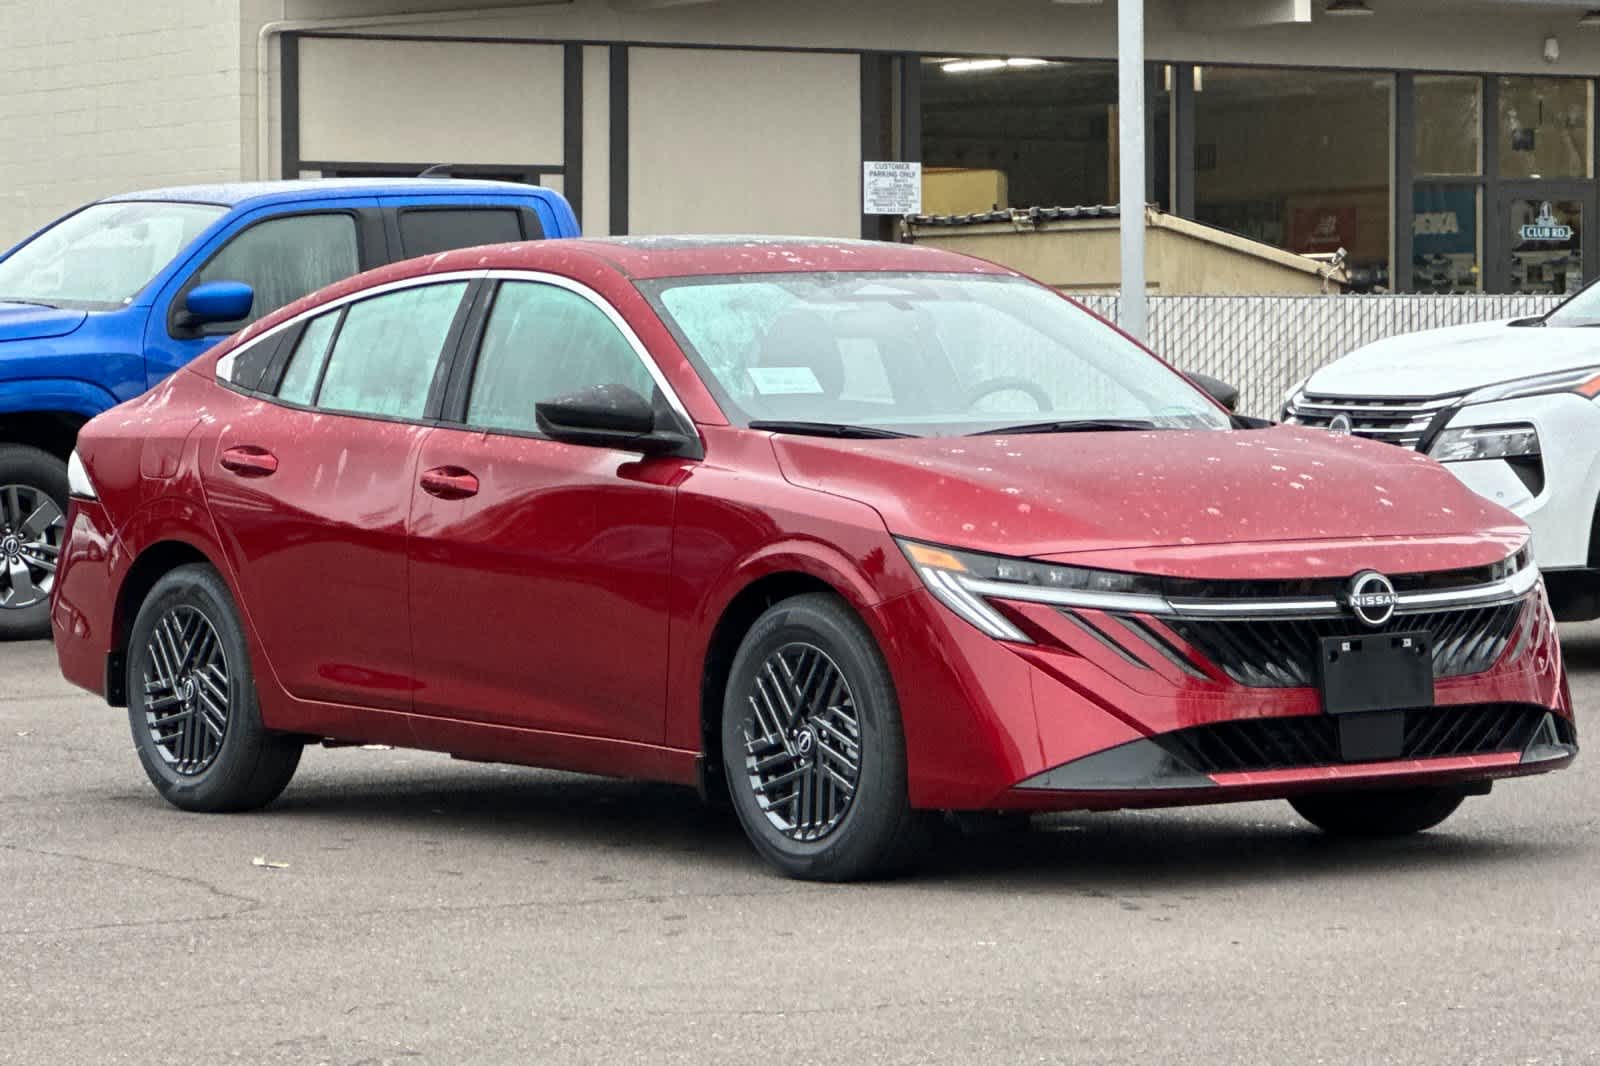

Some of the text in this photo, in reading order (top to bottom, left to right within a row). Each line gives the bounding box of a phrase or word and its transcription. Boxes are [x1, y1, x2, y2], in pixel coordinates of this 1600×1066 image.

[1526, 227, 1568, 238] CLUB RD.
[1350, 594, 1398, 606] NISSAN
